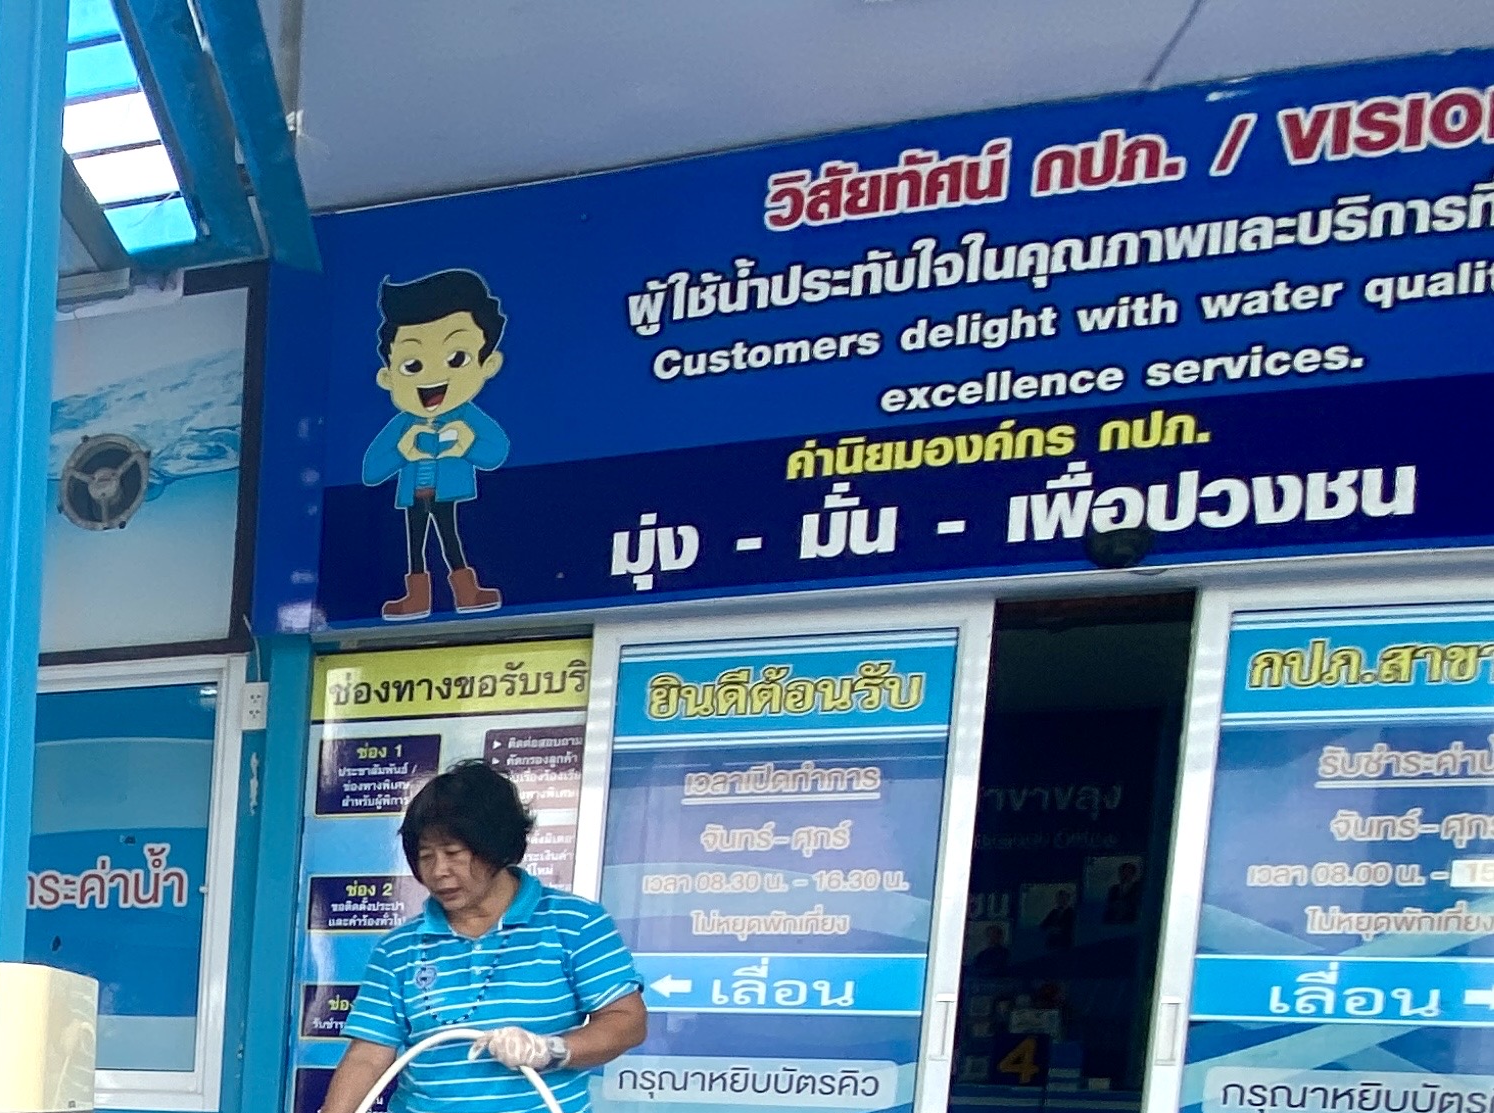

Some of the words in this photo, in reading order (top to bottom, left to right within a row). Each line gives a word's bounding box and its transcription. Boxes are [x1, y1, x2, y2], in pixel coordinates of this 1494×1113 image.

[765, 136, 1012, 231] วิสัยทัศน์
[1031, 129, 1187, 199] กปภ.
[1209, 113, 1257, 176] /
[1278, 85, 1494, 165] VISIO
[653, 330, 881, 380] Customers
[901, 305, 1057, 351] delight
[1077, 293, 1177, 336] with
[1201, 281, 1343, 319] water
[881, 366, 1124, 412] excellence
[1146, 344, 1364, 387] services.
[786, 420, 1074, 479] ค่านิยมองค์กร
[1099, 410, 1211, 452] กปภ.
[611, 512, 700, 591] มุ่ง
[735, 536, 763, 551] -
[800, 482, 898, 559] มั่น
[937, 520, 966, 534] -
[1006, 461, 1416, 543] เพื่อปวงชน
[646, 660, 925, 720] ยินดีต้อนรับ
[394, 743, 403, 758] 1
[684, 761, 881, 795] เวลาเปิดทำการ
[1329, 808, 1494, 849] จันทร์-ศุก
[382, 882, 393, 896] 2
[643, 873, 691, 894] เวลา
[694, 871, 761, 892] 08.30
[812, 870, 880, 891] 16.30
[1247, 864, 1306, 887] เวลา
[1310, 862, 1393, 887] 08.00
[711, 957, 856, 1007] เลื่อน
[1269, 961, 1442, 1018] เลื่อน
[618, 1066, 880, 1099] กรุณาหยิบบัตรคิว
[997, 1035, 1040, 1084] 4
